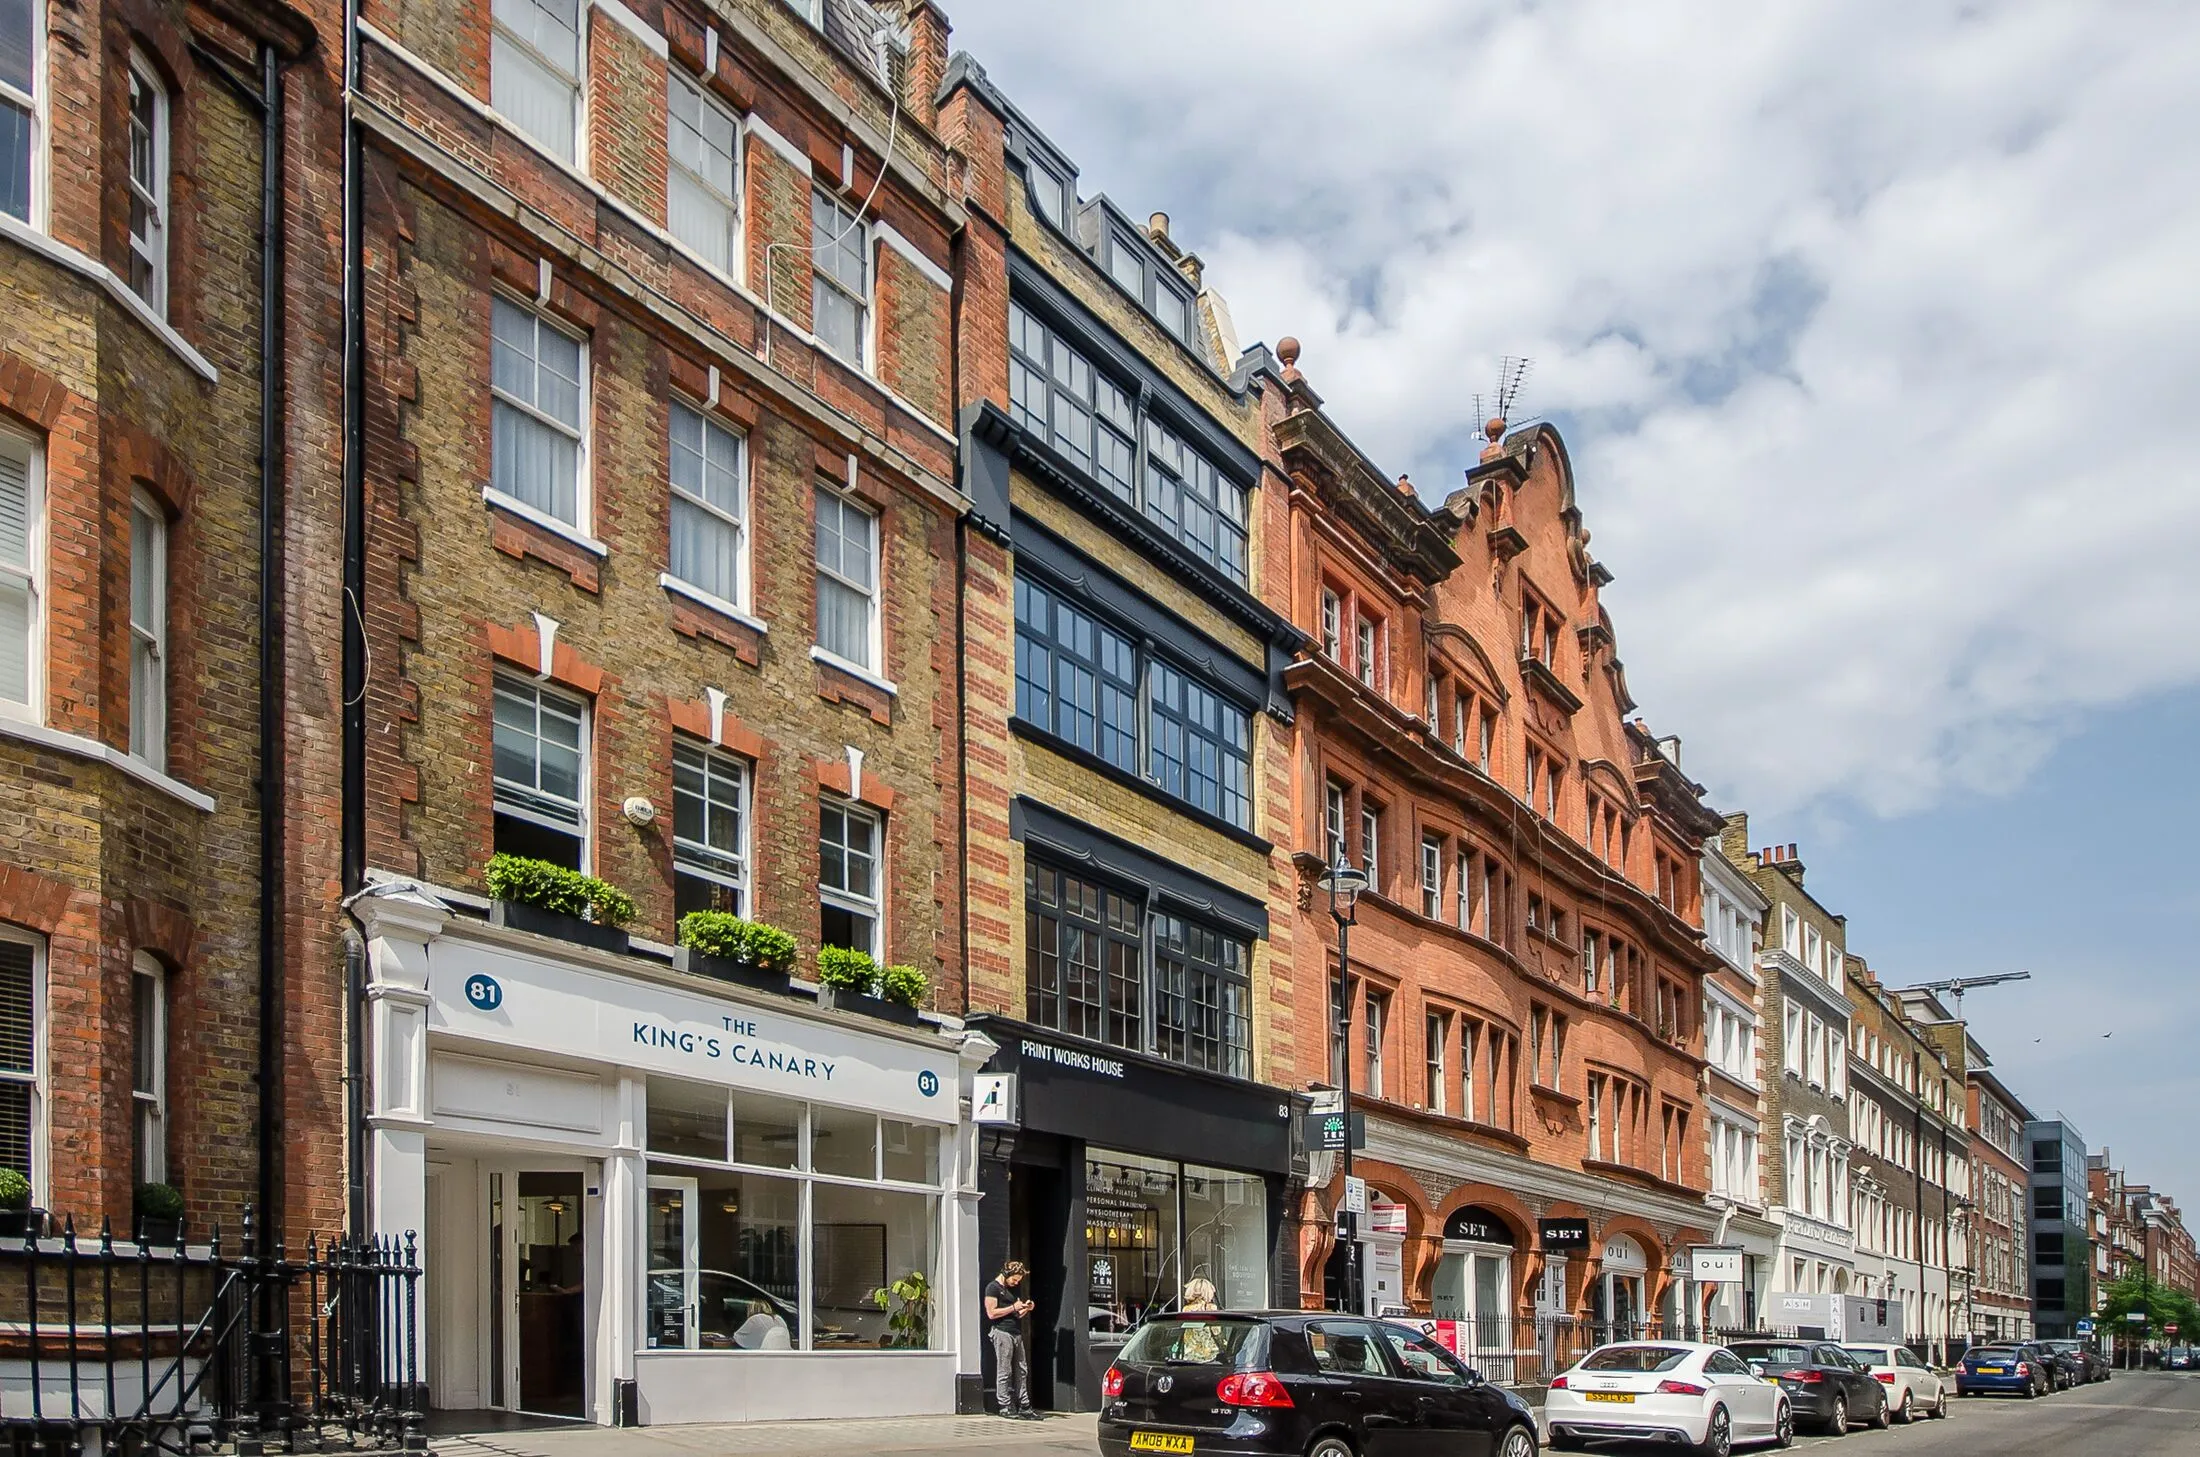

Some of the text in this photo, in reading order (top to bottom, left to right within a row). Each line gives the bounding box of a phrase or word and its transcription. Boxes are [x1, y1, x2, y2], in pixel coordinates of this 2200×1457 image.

[470, 982, 496, 1003] 81
[722, 1016, 757, 1037] THE
[633, 1022, 836, 1081] KING'S CANARY
[1021, 1039, 1124, 1078] PRINT WORKS HOUSE
[920, 1075, 935, 1092] 81
[1278, 1104, 1289, 1118] 83
[1323, 1130, 1344, 1139] TEN
[1086, 1196, 1147, 1210] PERSONAL TRAINING
[1086, 1207, 1134, 1218] PHYSIOTHERAPY
[1086, 1219, 1116, 1228] MASSAGE
[1459, 1221, 1488, 1237] SET
[1545, 1229, 1583, 1239] SET
[1607, 1241, 1628, 1260] oui
[1701, 1257, 1733, 1269] oui
[1093, 1276, 1112, 1285] TEN
[1135, 1432, 1187, 1450] AM08 WXA
